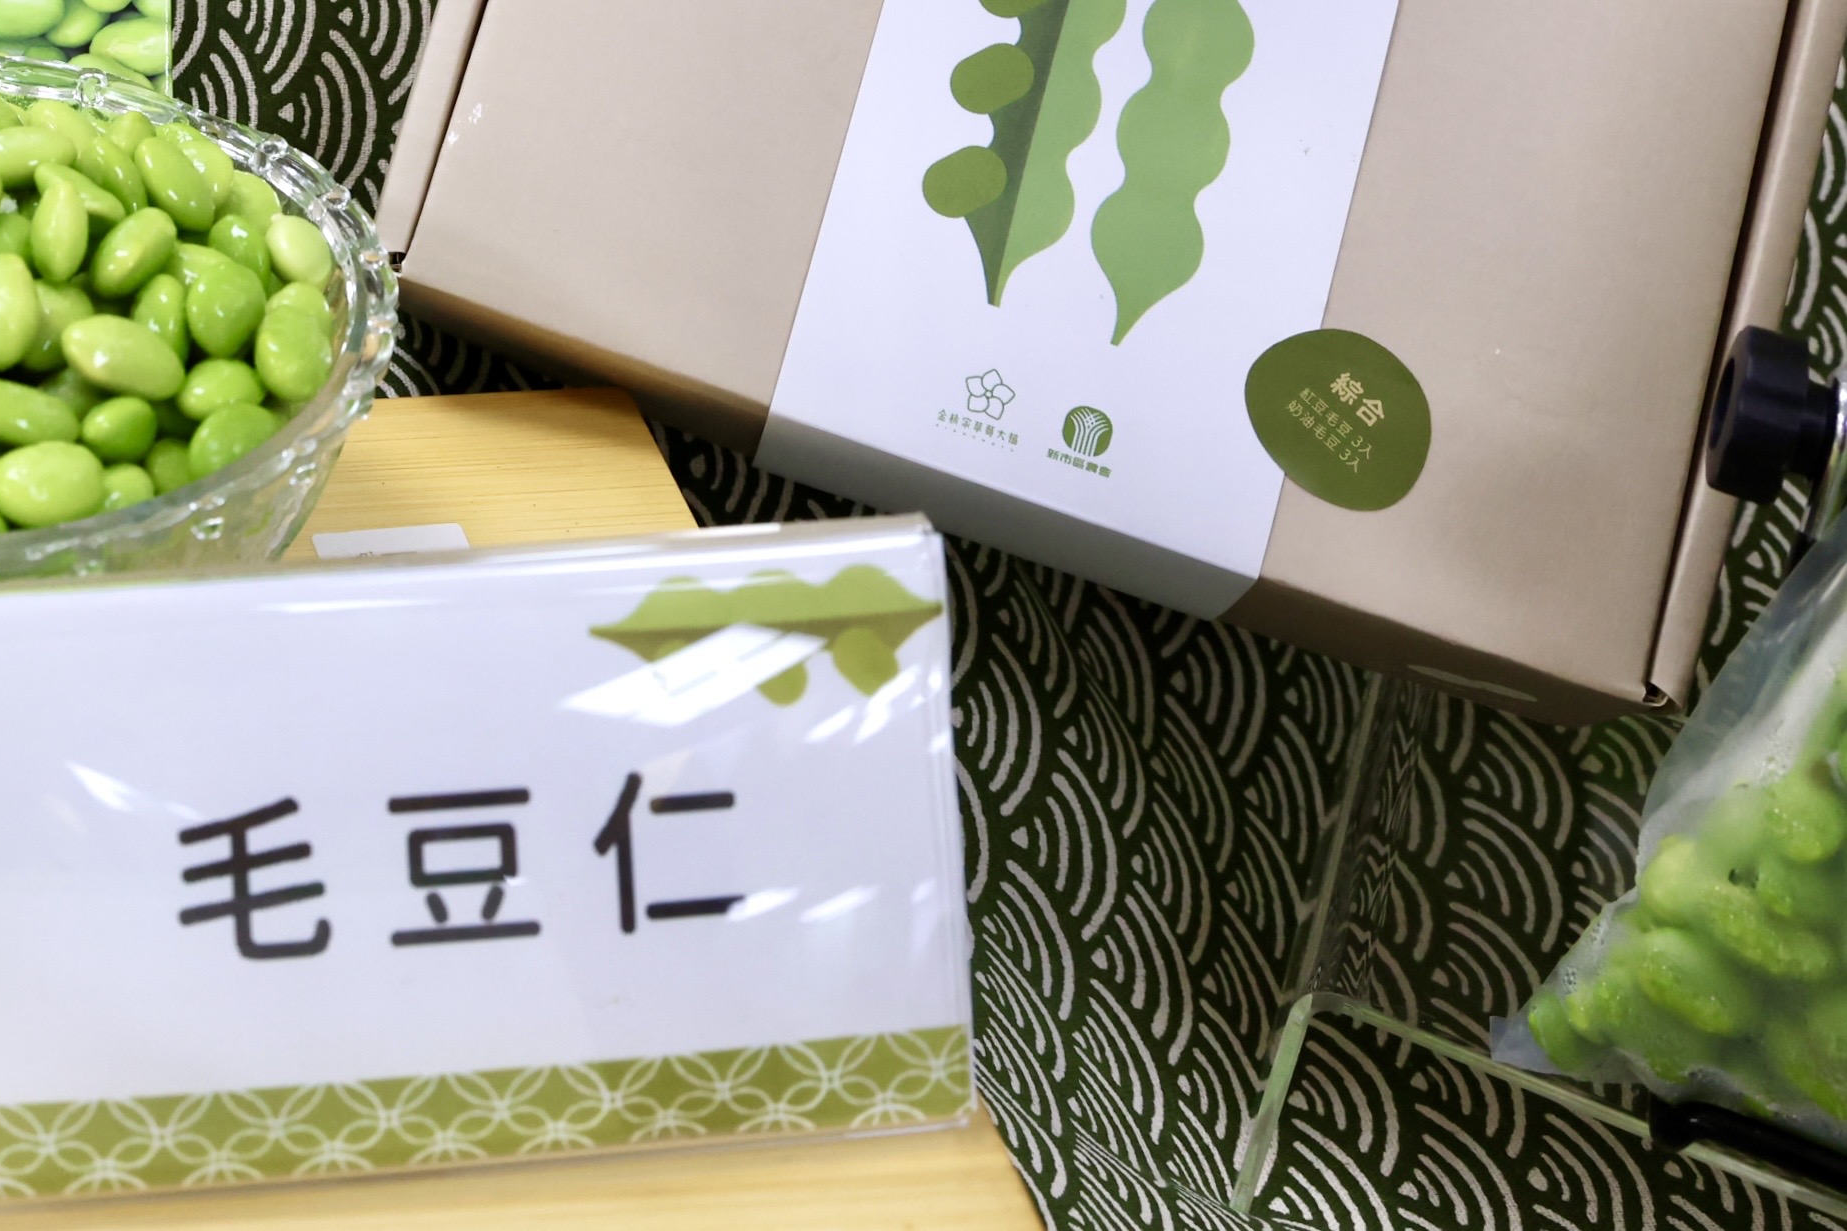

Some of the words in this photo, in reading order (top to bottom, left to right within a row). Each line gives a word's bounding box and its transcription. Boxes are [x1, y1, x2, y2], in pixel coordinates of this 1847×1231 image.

[1286, 399, 1342, 452] 奶油毛豆
[1338, 448, 1362, 474] 3入
[1299, 387, 1353, 439] 紅豆毛豆
[1351, 435, 1373, 460] 3入
[1330, 372, 1385, 428] 綜合
[178, 771, 751, 959] 毛豆仁
